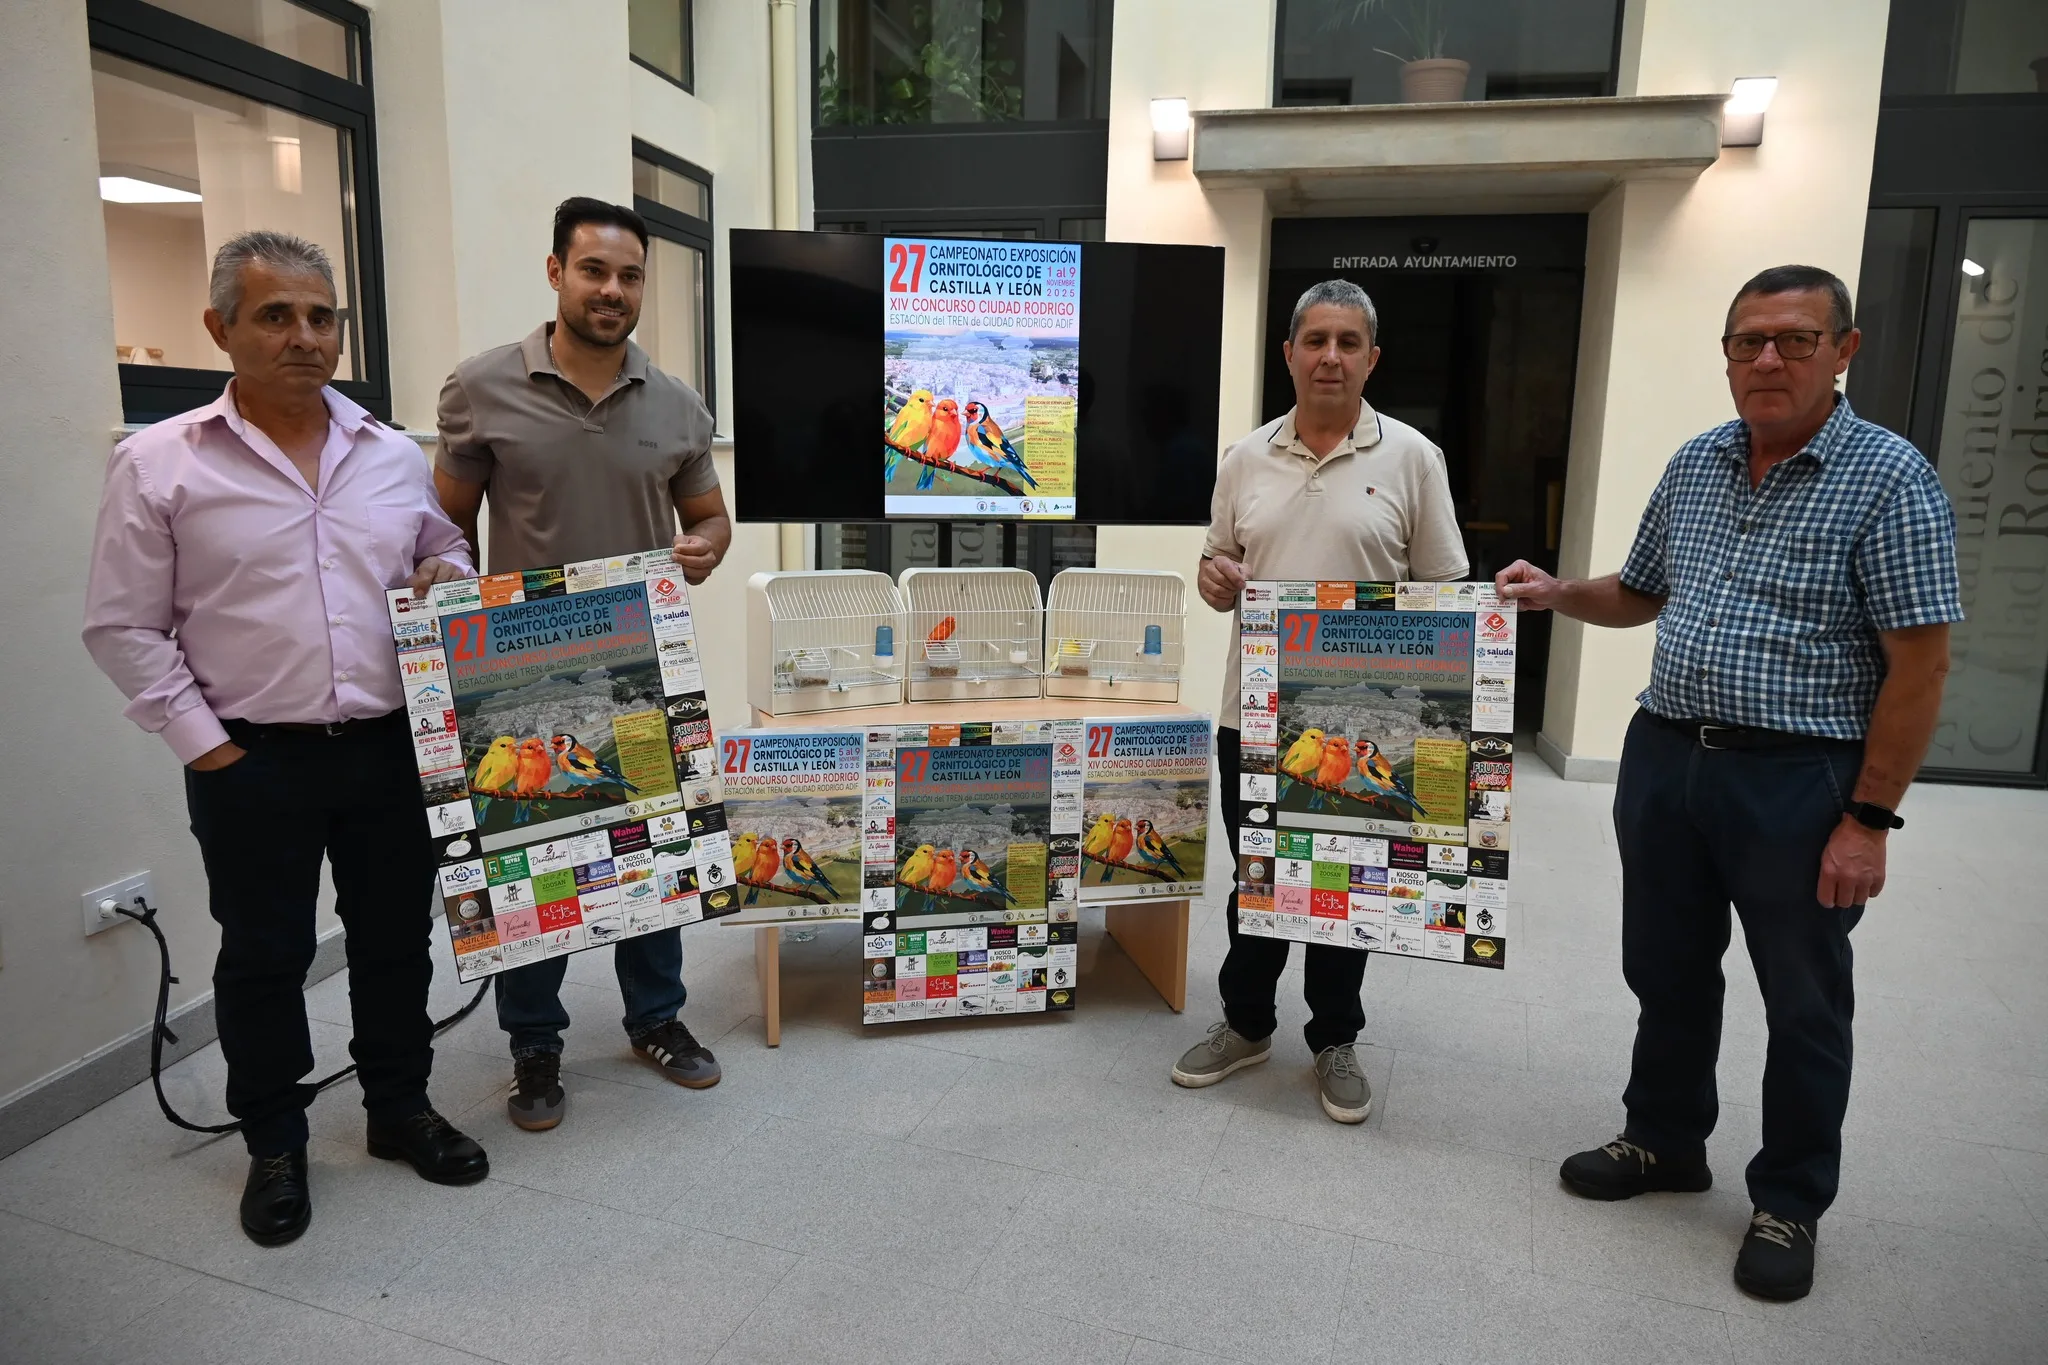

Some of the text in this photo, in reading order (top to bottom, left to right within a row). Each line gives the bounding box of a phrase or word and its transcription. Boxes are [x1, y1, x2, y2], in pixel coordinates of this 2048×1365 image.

[930, 246, 1076, 263] CAMPEONATO EXPOSICIÓN
[890, 244, 926, 293] 27
[1333, 256, 1516, 268] ENTRADA AYUNTAMIENTO
[929, 260, 1041, 279] ORNITOLÓGICO DE
[1047, 267, 1076, 277] 1 al 9
[930, 279, 1041, 296] CASTILLA Y LEÓN
[890, 298, 1074, 315] XIV CONCURSO CIUDAD RODRIGO
[890, 313, 1073, 328] ESTACIÓN del TREN de CIUDAD RODRIGO ADIF
[492, 600, 572, 624] CAMPEONATO
[576, 587, 641, 609] EXPOSICIÓN
[655, 596, 680, 604] emilio
[664, 610, 689, 620] saluda
[1323, 615, 1469, 628] CAMPEONATO EXPOSICIÓN
[494, 607, 610, 638] ORNITOLÓGICO DE
[394, 623, 429, 636] Lasarte
[1284, 614, 1319, 653] 27
[1322, 626, 1433, 641] ORNITOLÓGICO DE
[449, 614, 487, 662] 27
[497, 621, 612, 653] CASTILLA Y LEÓN
[456, 631, 648, 678] XIV CONCURSO CIUDAD RODRIGO
[1322, 641, 1434, 655] CASTILLA Y LEÓN
[1487, 647, 1513, 656] saluda
[458, 644, 649, 689] ESTACIÓN del TREN de CIUDAD RODRIGO ADIF
[1285, 656, 1467, 672] XIV CONCURSO CIUDAD RODRIGO
[1284, 667, 1466, 683] ESTACIÓN del TREN de CIUDAD RODRIGO ADIF
[418, 696, 440, 704] BOBY
[674, 721, 709, 737] FRUTAS
[1115, 722, 1208, 735] CAMPEONATO EXPOSICIÓN
[754, 735, 860, 749] CAMPEONATO EXPOSICIÓN
[1088, 726, 1112, 757] 27
[1114, 734, 1186, 746] ORNITOLÓGICO DE
[724, 739, 751, 773] 27
[754, 748, 835, 760] ORNITOLÓGICO DE
[839, 748, 843, 756] 5
[933, 747, 1048, 759] CAMPEONATO EXPOSICIÓN
[1114, 744, 1186, 757] CASTILLA Y LEÓN
[754, 759, 835, 772] CASTILLA Y LEÓN
[901, 750, 930, 783] 27
[932, 758, 1005, 770] ORNITOLÓGICO
[1009, 759, 1020, 768] DE
[1088, 757, 1207, 769] XIV CONCURSO CIUDAD RODRIGO
[1473, 762, 1510, 774] FRUTAS
[725, 772, 859, 786] XIV CONCURSO CIUDAD RODRIGO
[932, 771, 980, 781] CASTILLA
[985, 771, 991, 779] Y
[995, 768, 1020, 779] LEÓN
[1088, 769, 1114, 778] ESTACIÓN
[724, 786, 754, 795] ESTACIÓN
[767, 786, 782, 794] TREN
[793, 785, 816, 793] CIUDAD
[613, 824, 644, 838] Wahou!
[1393, 843, 1424, 853] Wahou!
[618, 857, 652, 871] EL PICOTEO
[622, 853, 645, 863] KIOSCO
[1397, 871, 1418, 879] KIOSCO
[1400, 878, 1424, 886] PICOTEO
[1276, 914, 1308, 924] FLORES
[503, 938, 540, 953] FLORES
